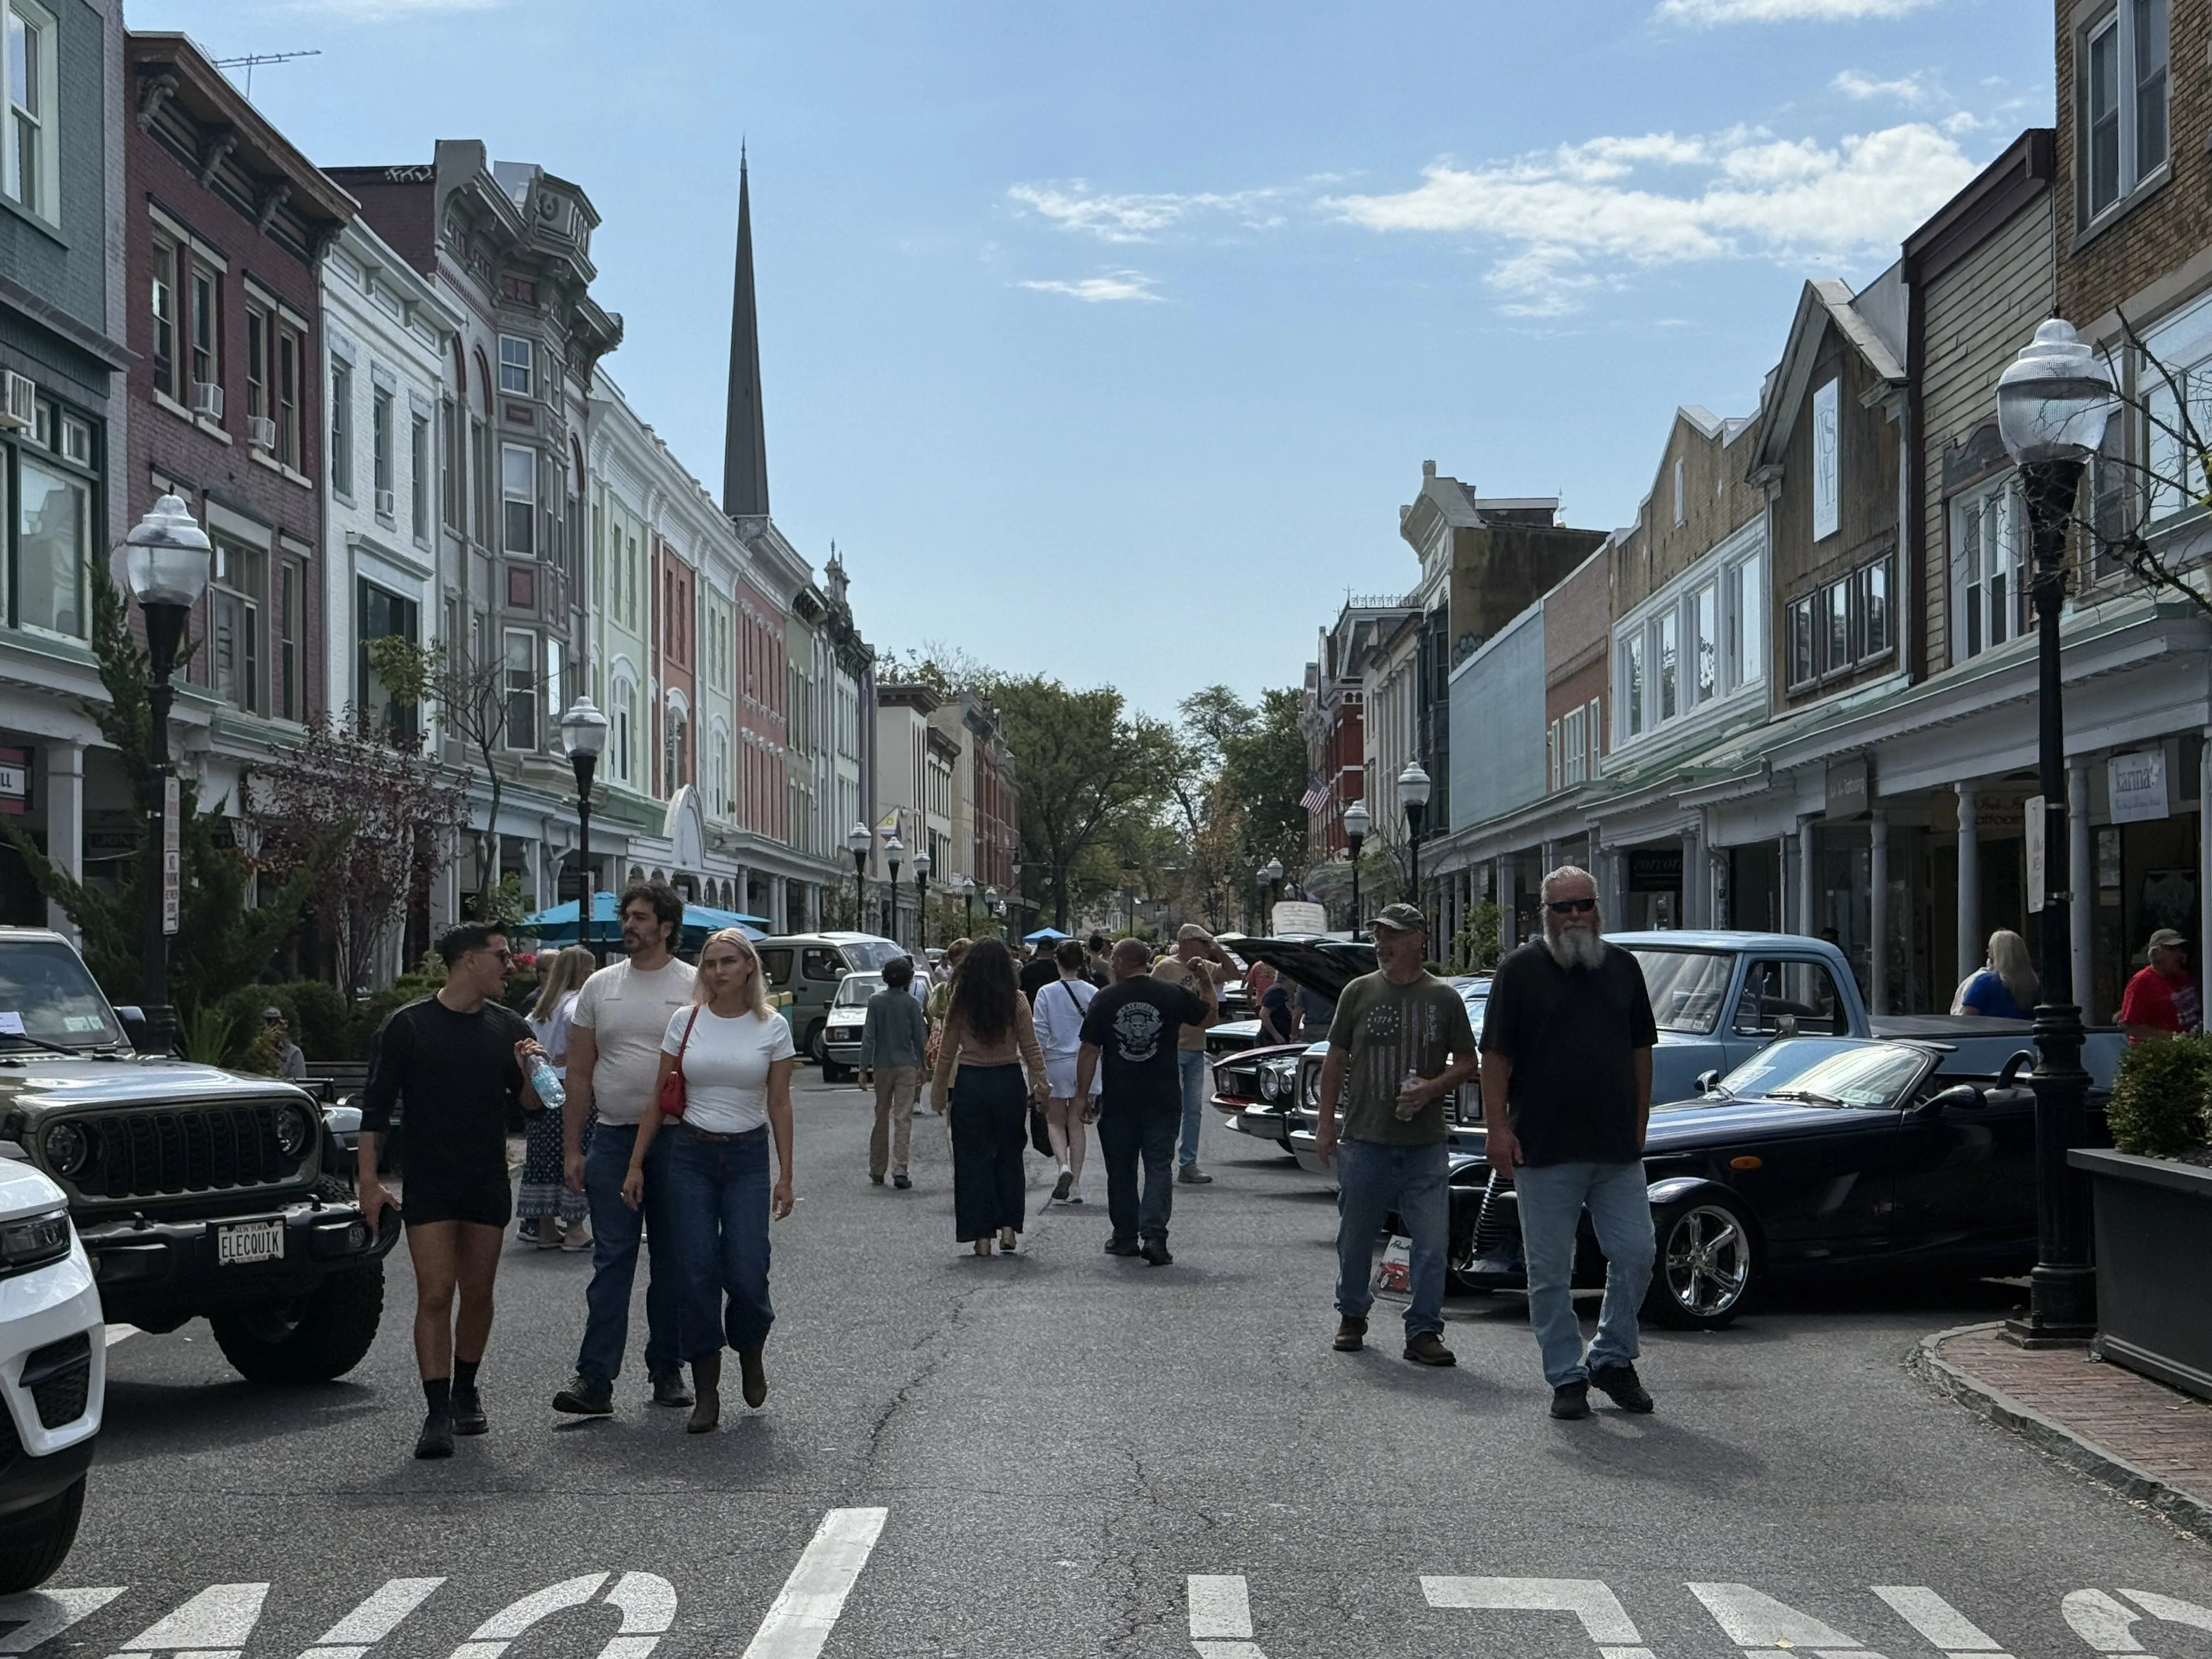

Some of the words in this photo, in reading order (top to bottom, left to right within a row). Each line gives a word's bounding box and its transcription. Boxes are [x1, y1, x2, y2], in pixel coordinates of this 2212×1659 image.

[1373, 1015, 1393, 1024] 1776
[251, 1223, 268, 1232] YORK
[222, 1231, 279, 1258] ELECQUIK
